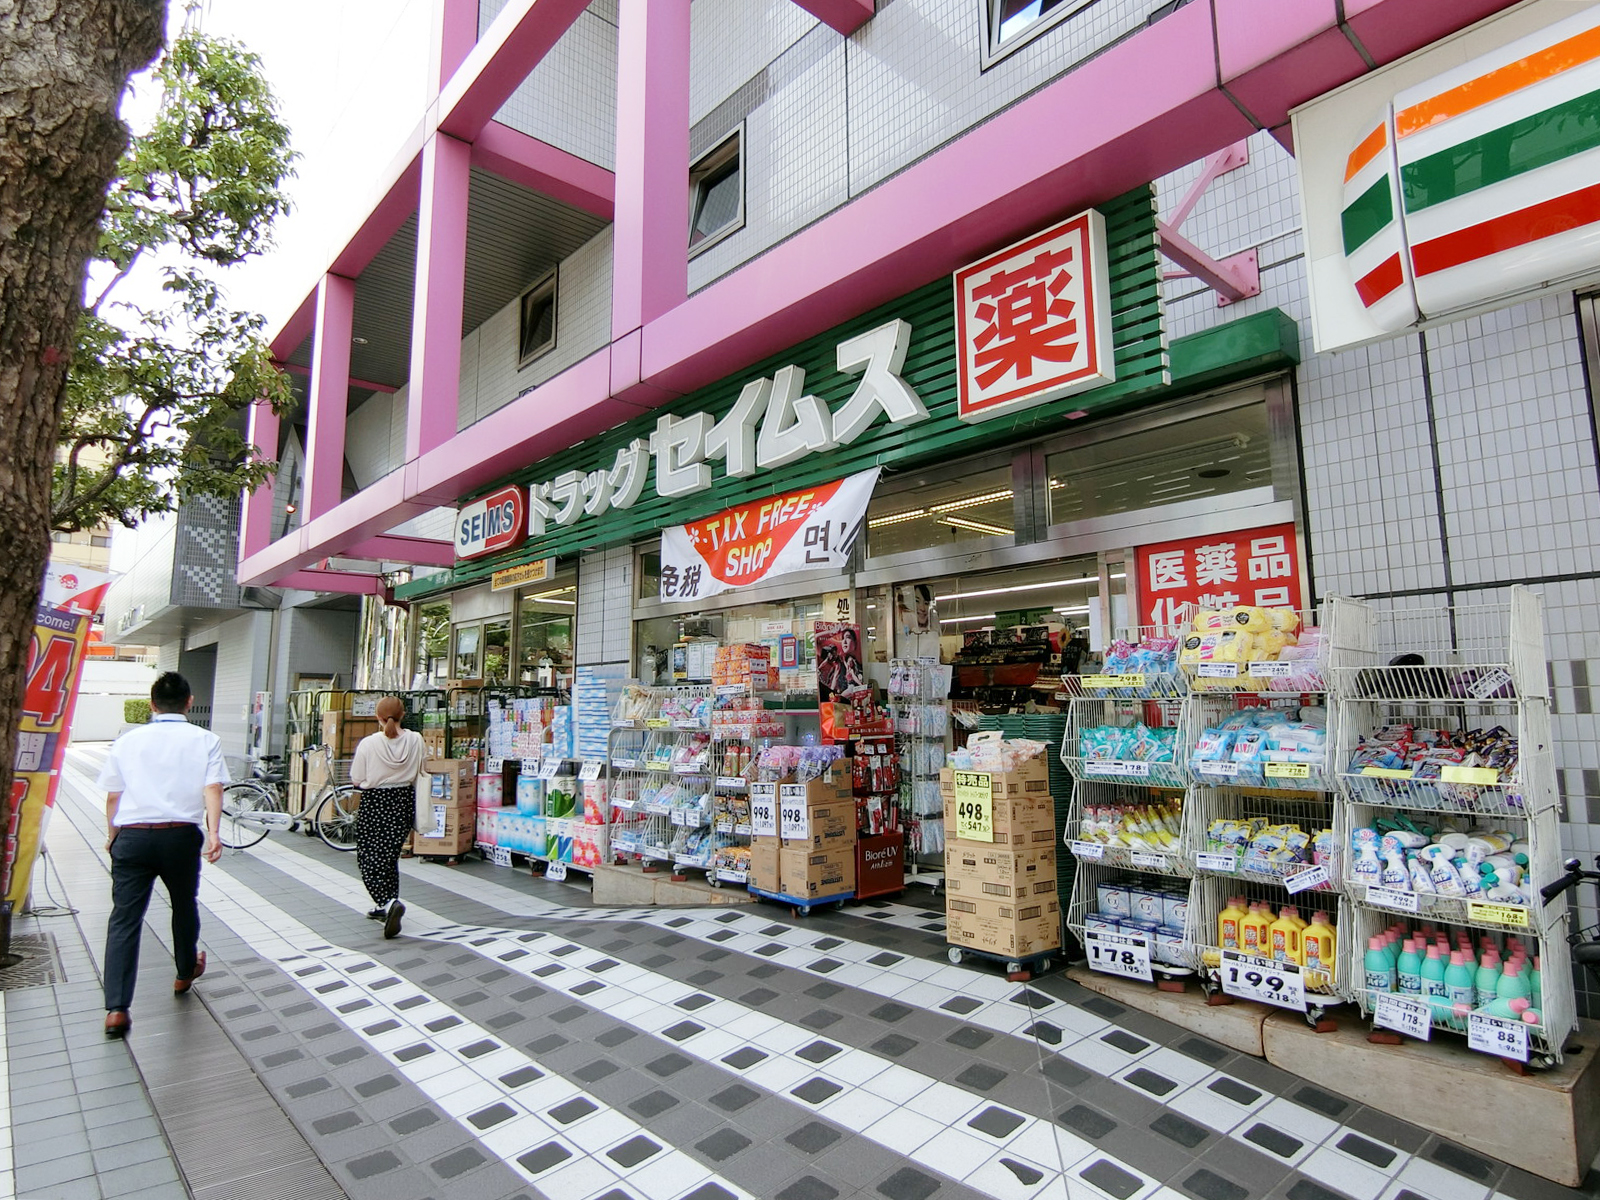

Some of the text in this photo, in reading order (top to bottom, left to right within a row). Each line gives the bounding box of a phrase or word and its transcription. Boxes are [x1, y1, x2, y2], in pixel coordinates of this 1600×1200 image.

[972, 246, 1078, 391] 薬
[460, 499, 515, 547] SEIMS
[706, 492, 815, 551] TAX FREE
[725, 537, 773, 578] SHOP
[1148, 535, 1292, 592] 医薬品
[661, 564, 702, 598] 免税
[753, 806, 769, 820] 998
[782, 808, 801, 823] 998
[958, 802, 983, 821] 498
[1092, 945, 1135, 965] 178
[1229, 967, 1284, 992] 199
[1267, 991, 1289, 1002] 218
[1402, 1012, 1418, 1025] 178
[1497, 1031, 1515, 1043] 88
